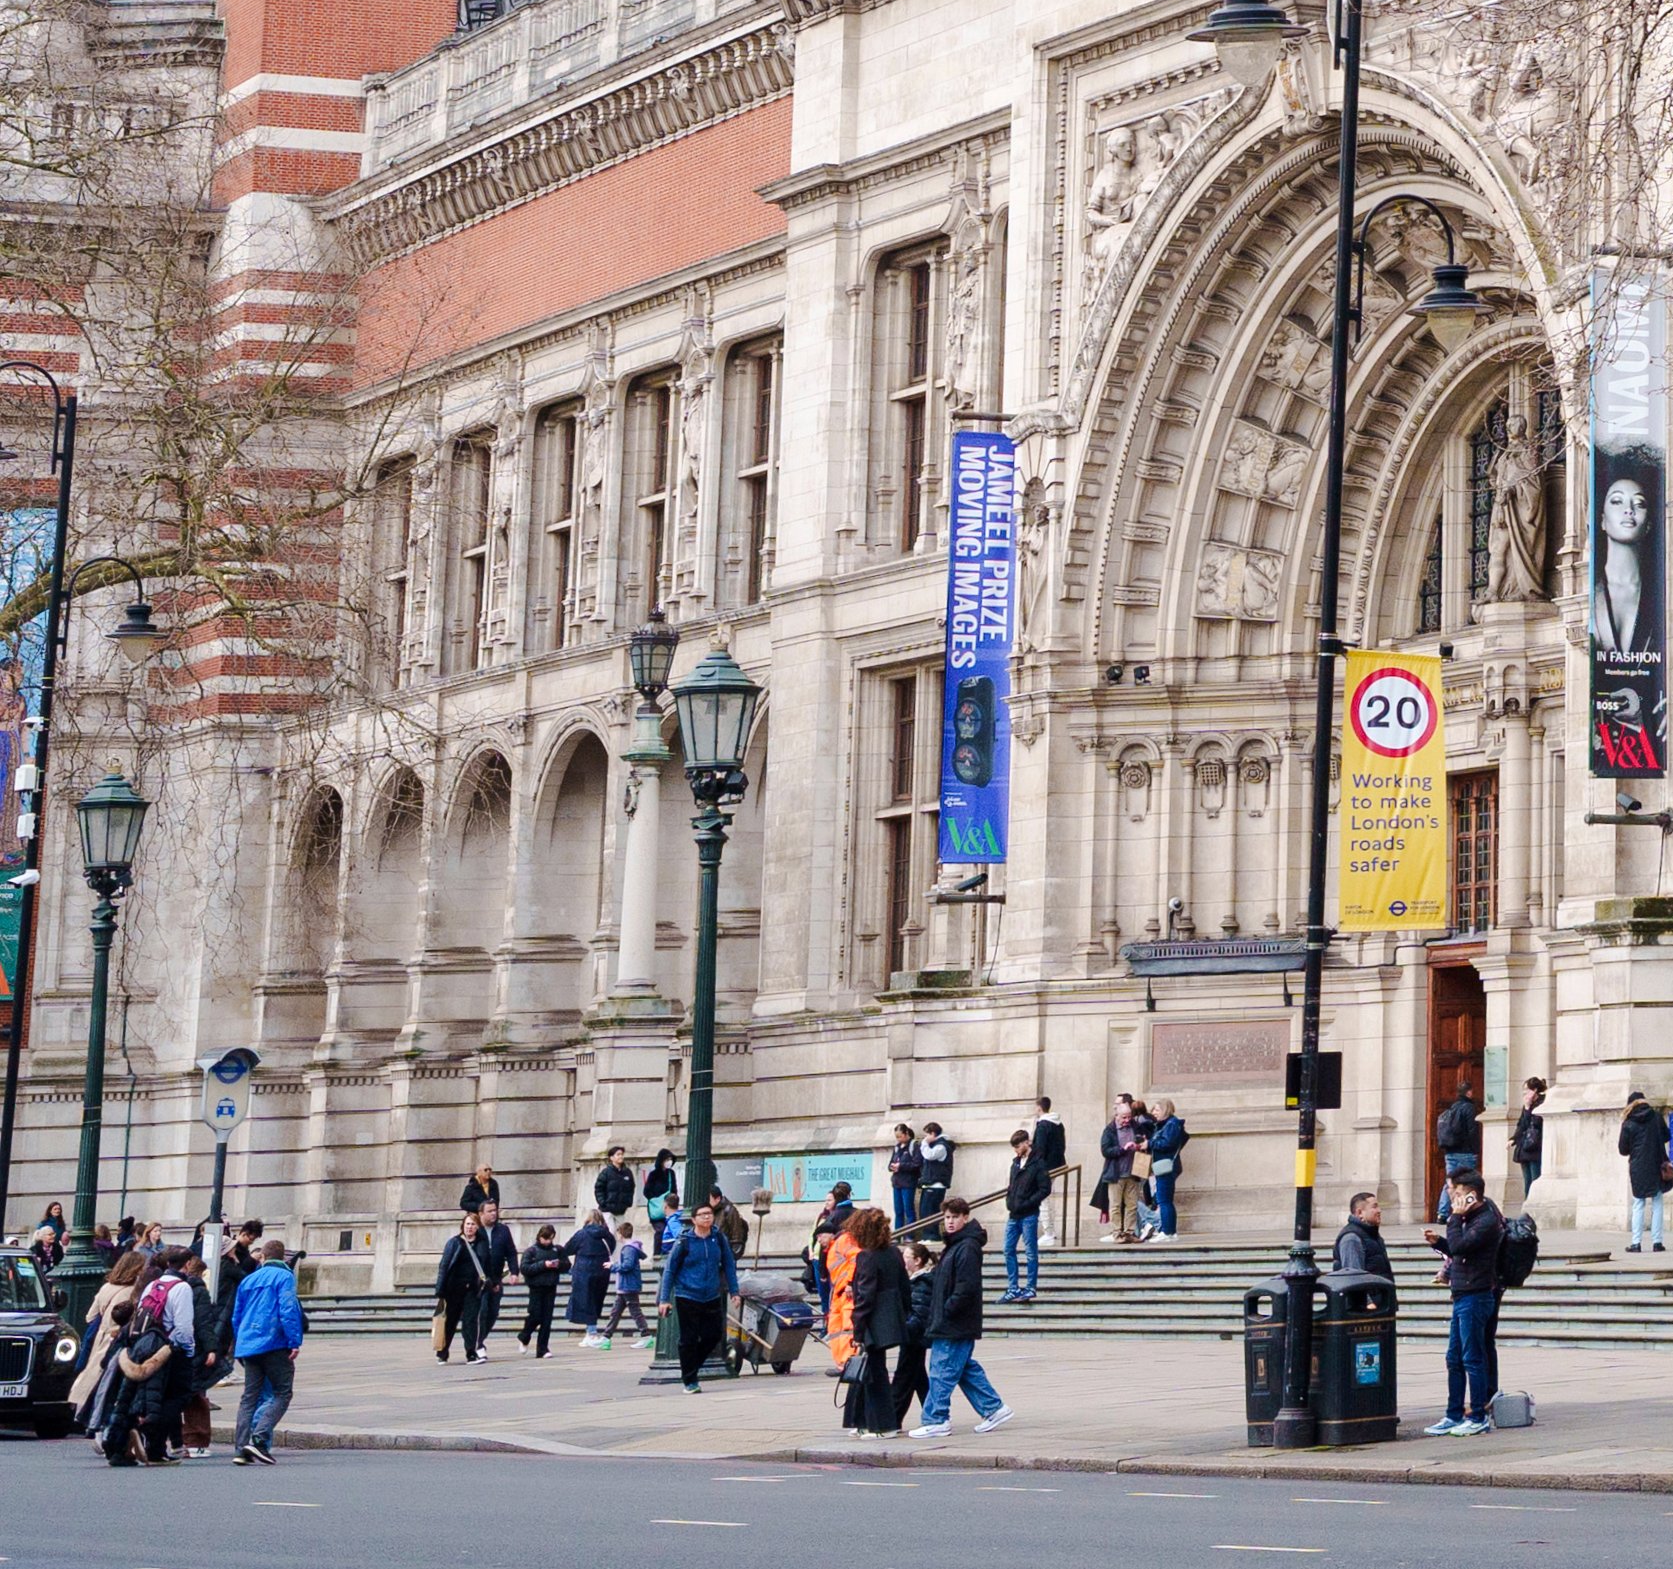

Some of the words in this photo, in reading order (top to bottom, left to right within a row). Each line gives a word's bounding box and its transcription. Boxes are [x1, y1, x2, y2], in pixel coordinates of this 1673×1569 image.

[955, 445, 986, 558] MOVING
[984, 444, 1014, 555] JAMEEL
[979, 559, 1010, 643] PRIZE
[950, 561, 980, 670] IMAGES
[1596, 650, 1607, 662] IN
[1609, 651, 1662, 664] FASHION
[1366, 695, 1421, 730] 20
[1596, 701, 1619, 711] BOSS
[1596, 722, 1662, 769] V&A
[1352, 773, 1432, 791] Working
[1351, 795, 1372, 810] to
[1380, 794, 1431, 809] make
[1351, 814, 1440, 830] London's
[945, 815, 1004, 857] V&A
[1350, 836, 1405, 851] roads
[1349, 856, 1400, 873] safer
[819, 1167, 837, 1181] GREAT
[2, 1386, 24, 1396] HDJ
